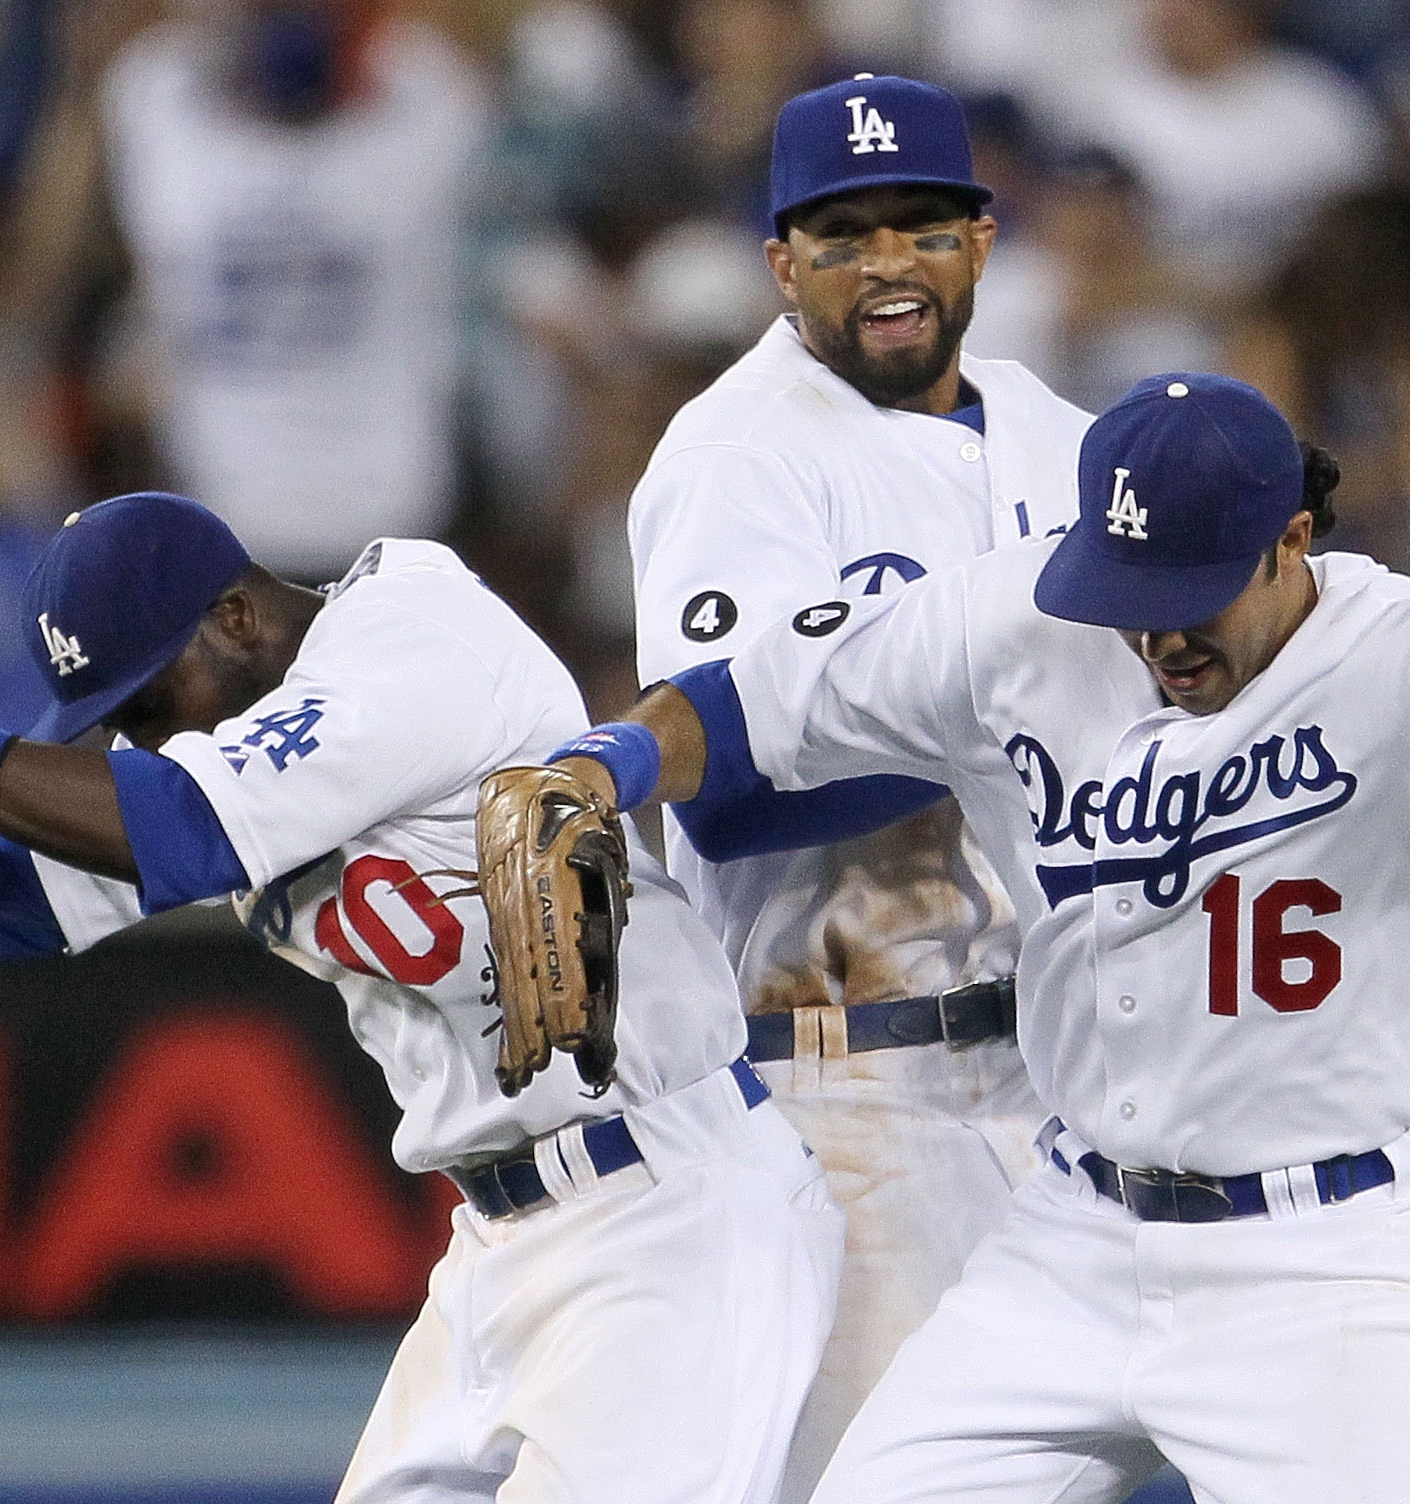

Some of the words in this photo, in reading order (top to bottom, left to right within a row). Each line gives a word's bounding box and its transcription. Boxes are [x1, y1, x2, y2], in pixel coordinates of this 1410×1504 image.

[845, 96, 899, 155] LA
[1106, 467, 1148, 540] LA
[37, 612, 89, 676] LA
[690, 598, 720, 633] 4
[802, 609, 842, 627] 4
[241, 699, 327, 773] LA
[1005, 725, 1357, 910] Dodgers
[536, 874, 565, 993] EASTON
[1202, 872, 1342, 1017] 16
